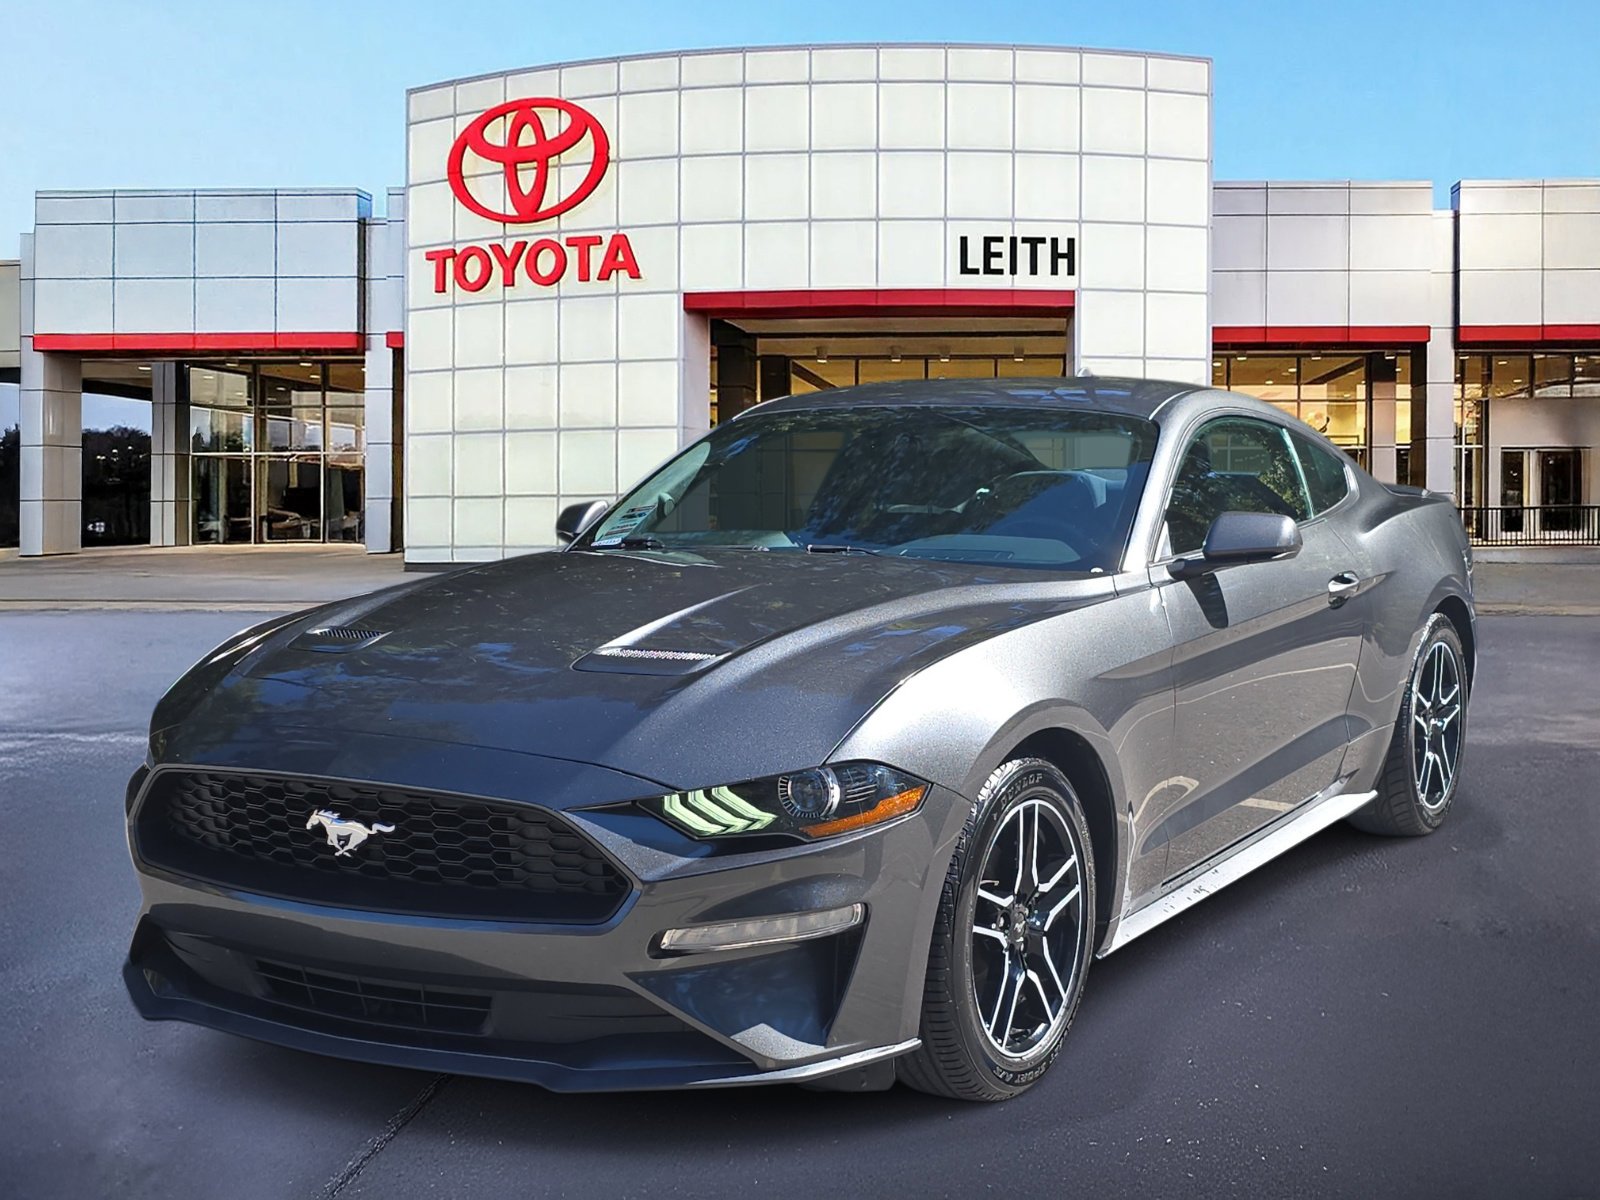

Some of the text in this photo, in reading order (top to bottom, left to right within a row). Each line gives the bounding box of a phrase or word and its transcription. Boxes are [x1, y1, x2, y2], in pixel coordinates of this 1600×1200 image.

[425, 233, 642, 293] TOYOTA
[960, 236, 1075, 276] LEITH
[1001, 773, 1043, 810] DUNLOP
